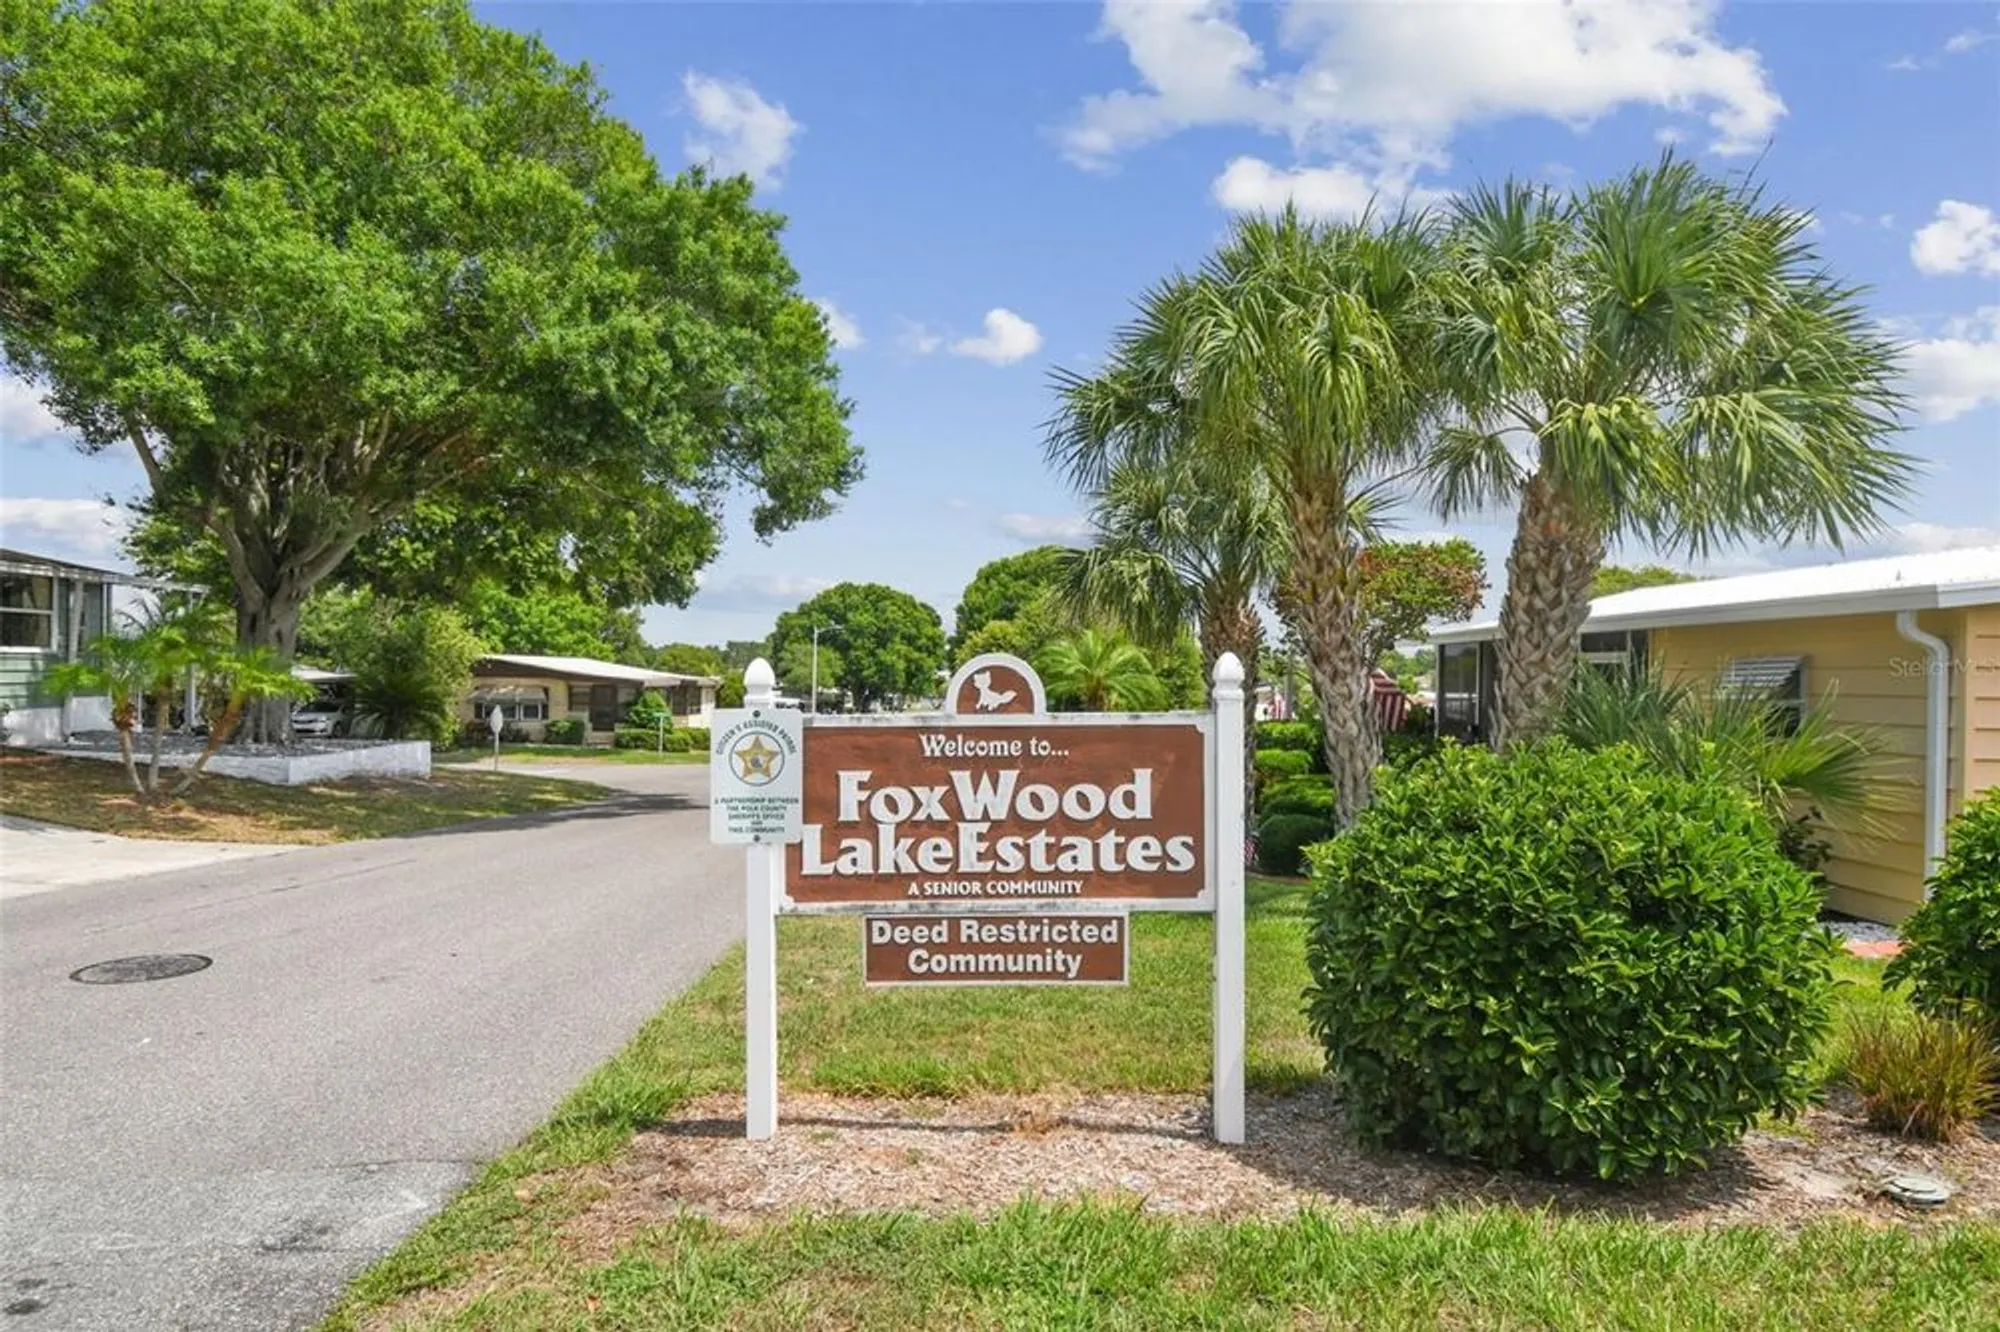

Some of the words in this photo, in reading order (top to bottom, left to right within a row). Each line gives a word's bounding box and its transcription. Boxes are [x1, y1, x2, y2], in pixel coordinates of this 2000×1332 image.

[920, 734, 1022, 757] Welcome
[1030, 738, 1069, 757] to...
[908, 881, 920, 896] A
[923, 880, 982, 896] SENIOR
[986, 879, 1083, 896] COMMUNITY
[871, 919, 949, 944] Deed
[960, 918, 1119, 944] Restricted
[907, 948, 1083, 979] Community
